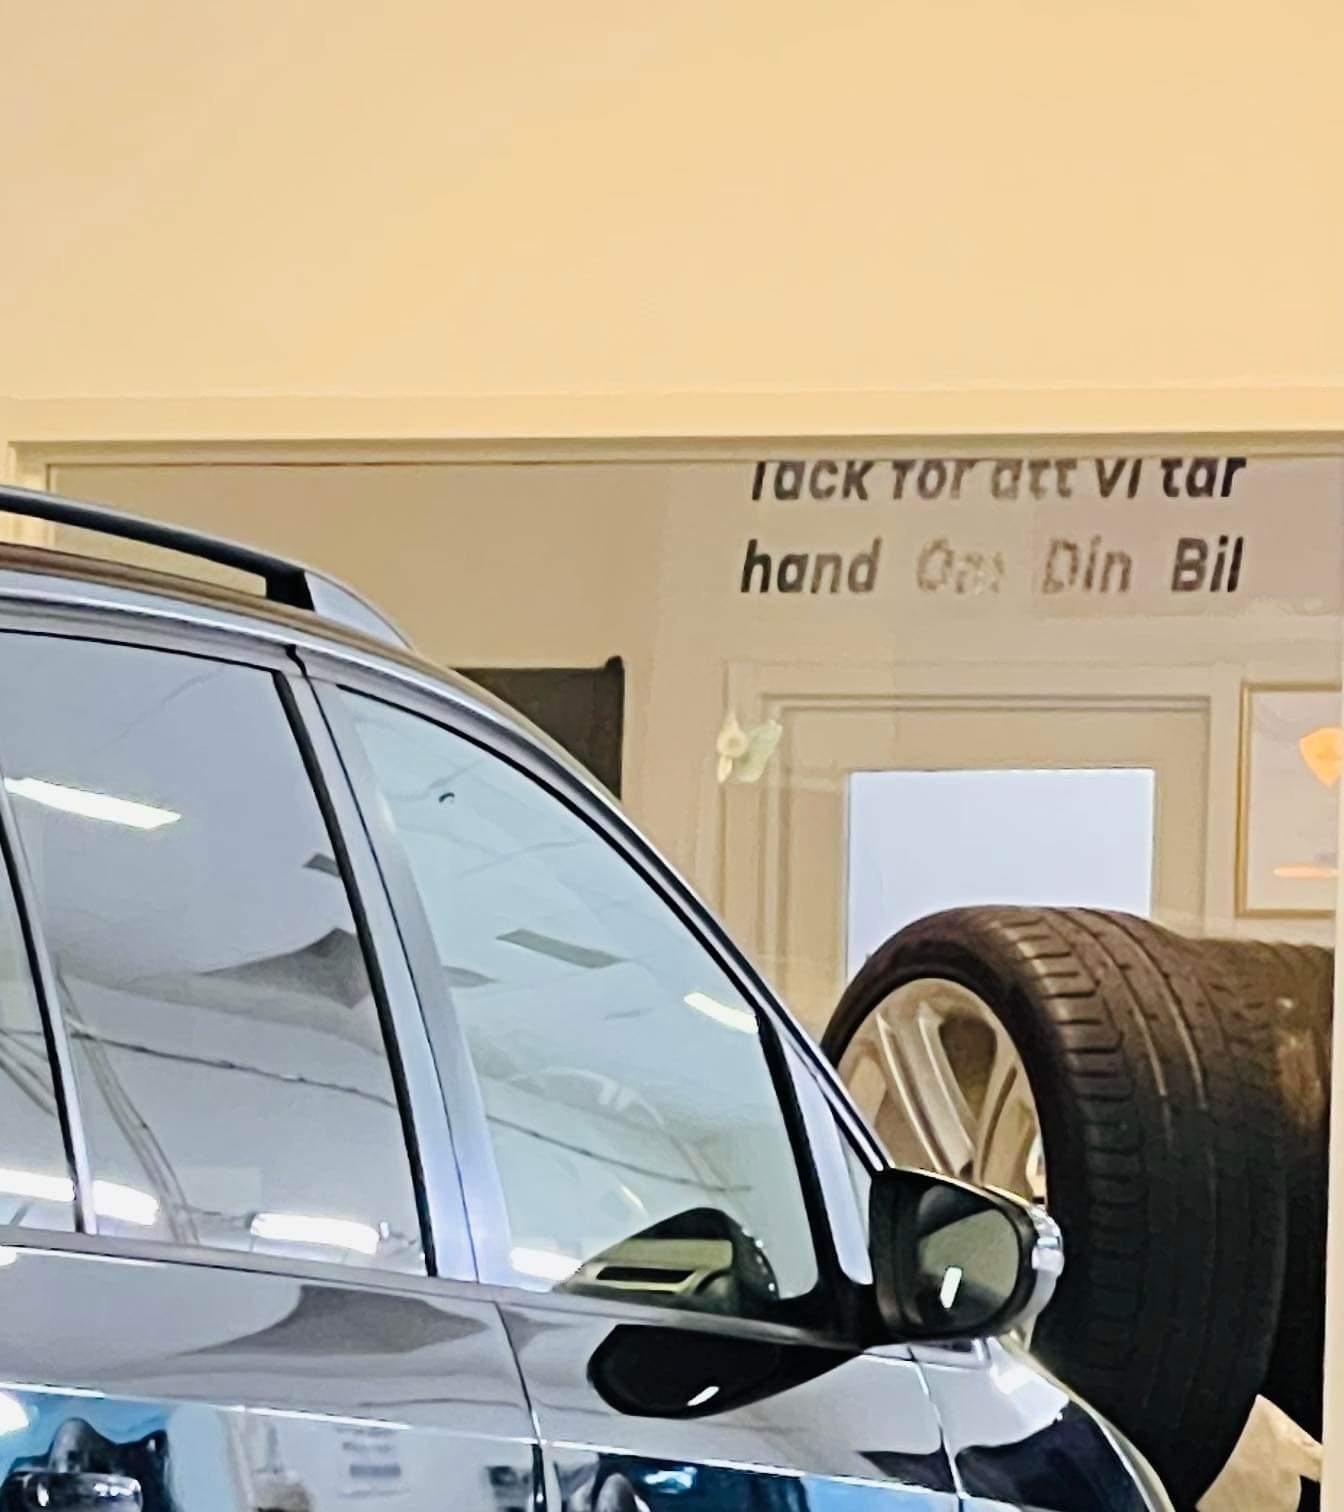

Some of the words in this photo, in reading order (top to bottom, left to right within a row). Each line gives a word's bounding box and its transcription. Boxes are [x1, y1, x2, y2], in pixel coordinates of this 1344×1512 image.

[740, 535, 882, 592] hand
[1043, 534, 1132, 594] Din
[1170, 534, 1244, 592] Bil
